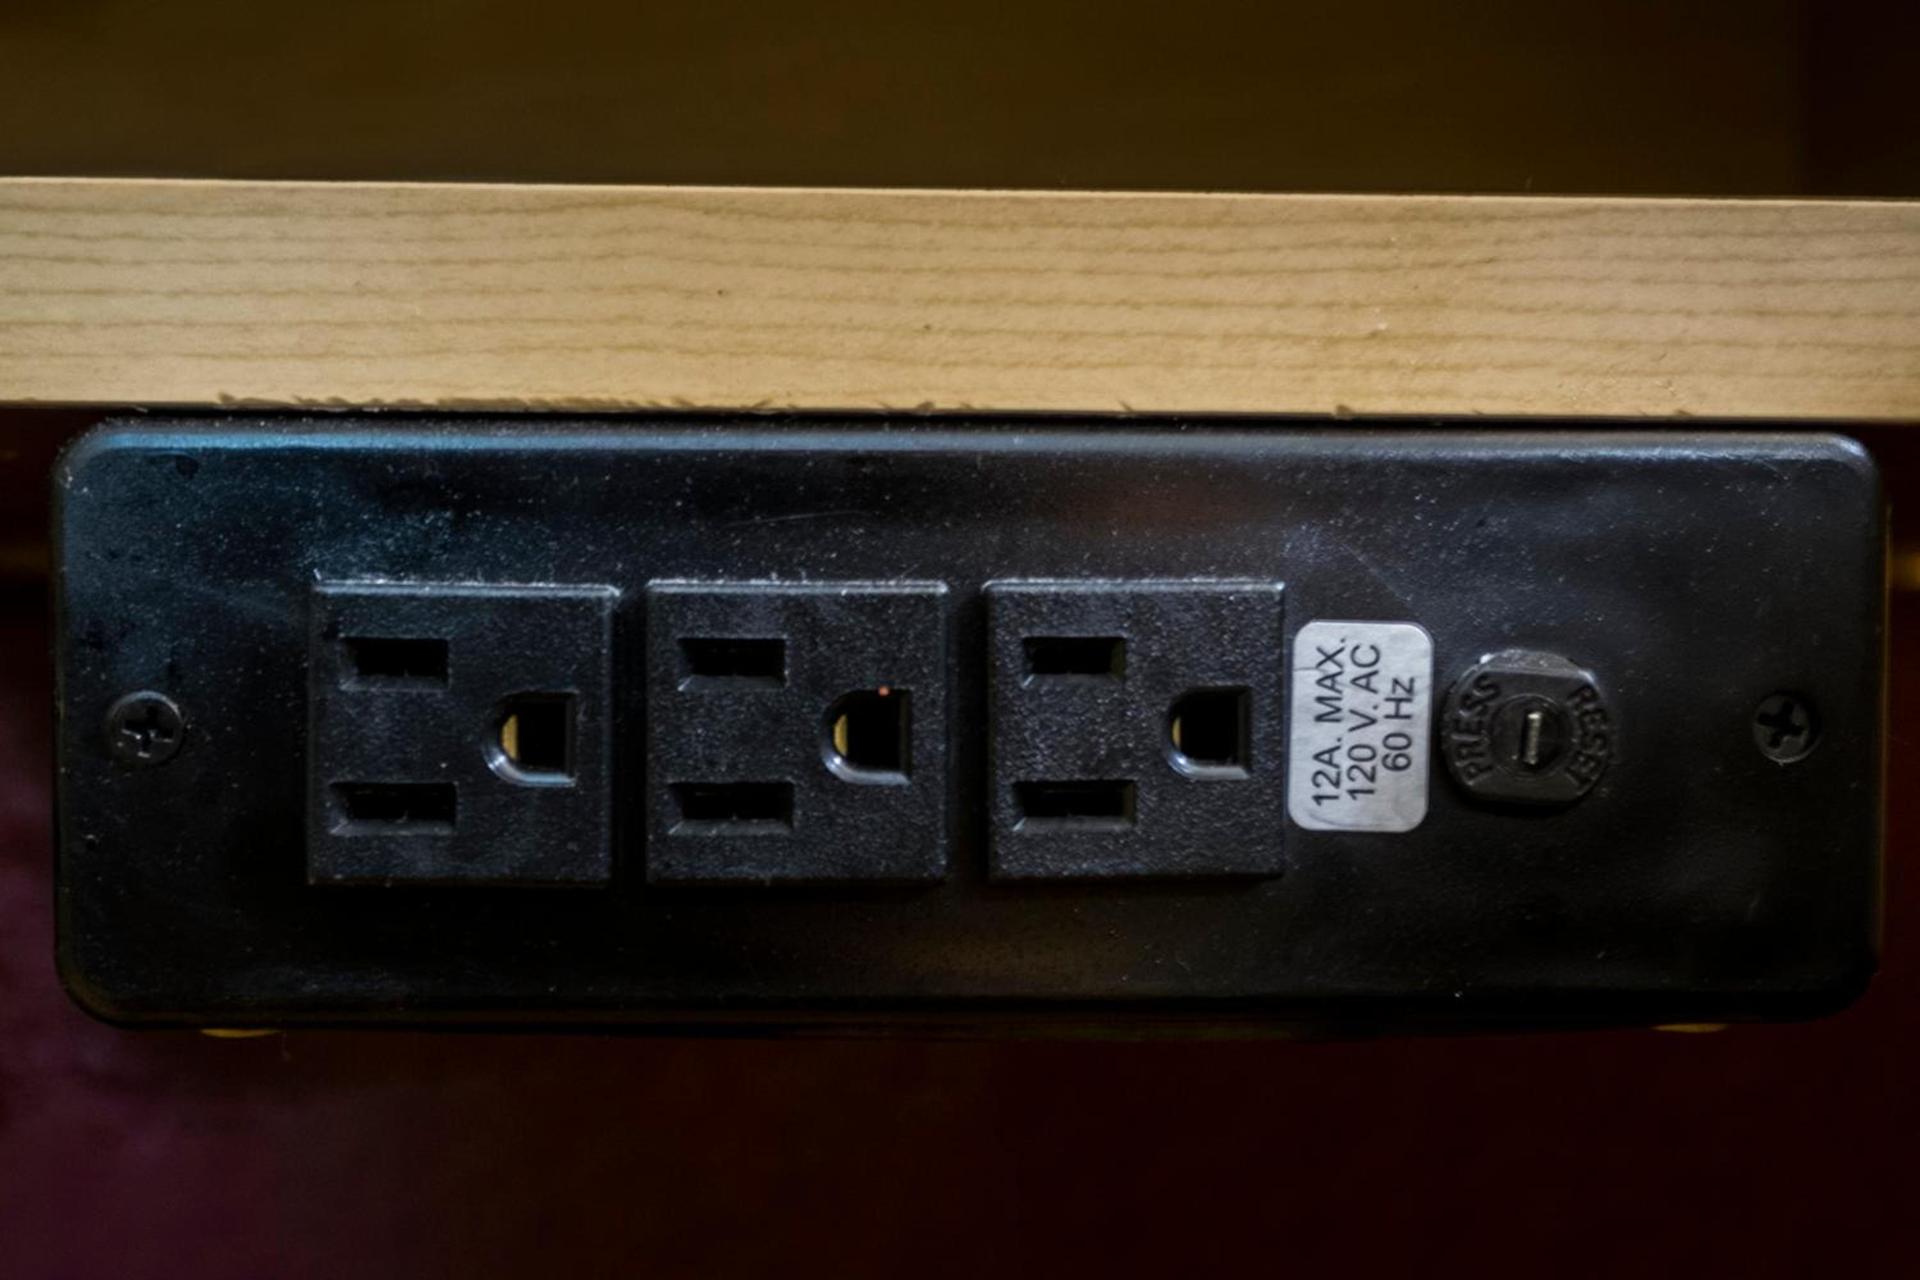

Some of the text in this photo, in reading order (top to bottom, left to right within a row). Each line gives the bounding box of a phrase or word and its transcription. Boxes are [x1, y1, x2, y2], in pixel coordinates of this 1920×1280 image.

[1311, 637, 1346, 805] 12A. MAX.
[1346, 644, 1381, 800] 120 V. AC
[1382, 676, 1415, 772] 60 Hz
[1450, 674, 1502, 787] PRESS
